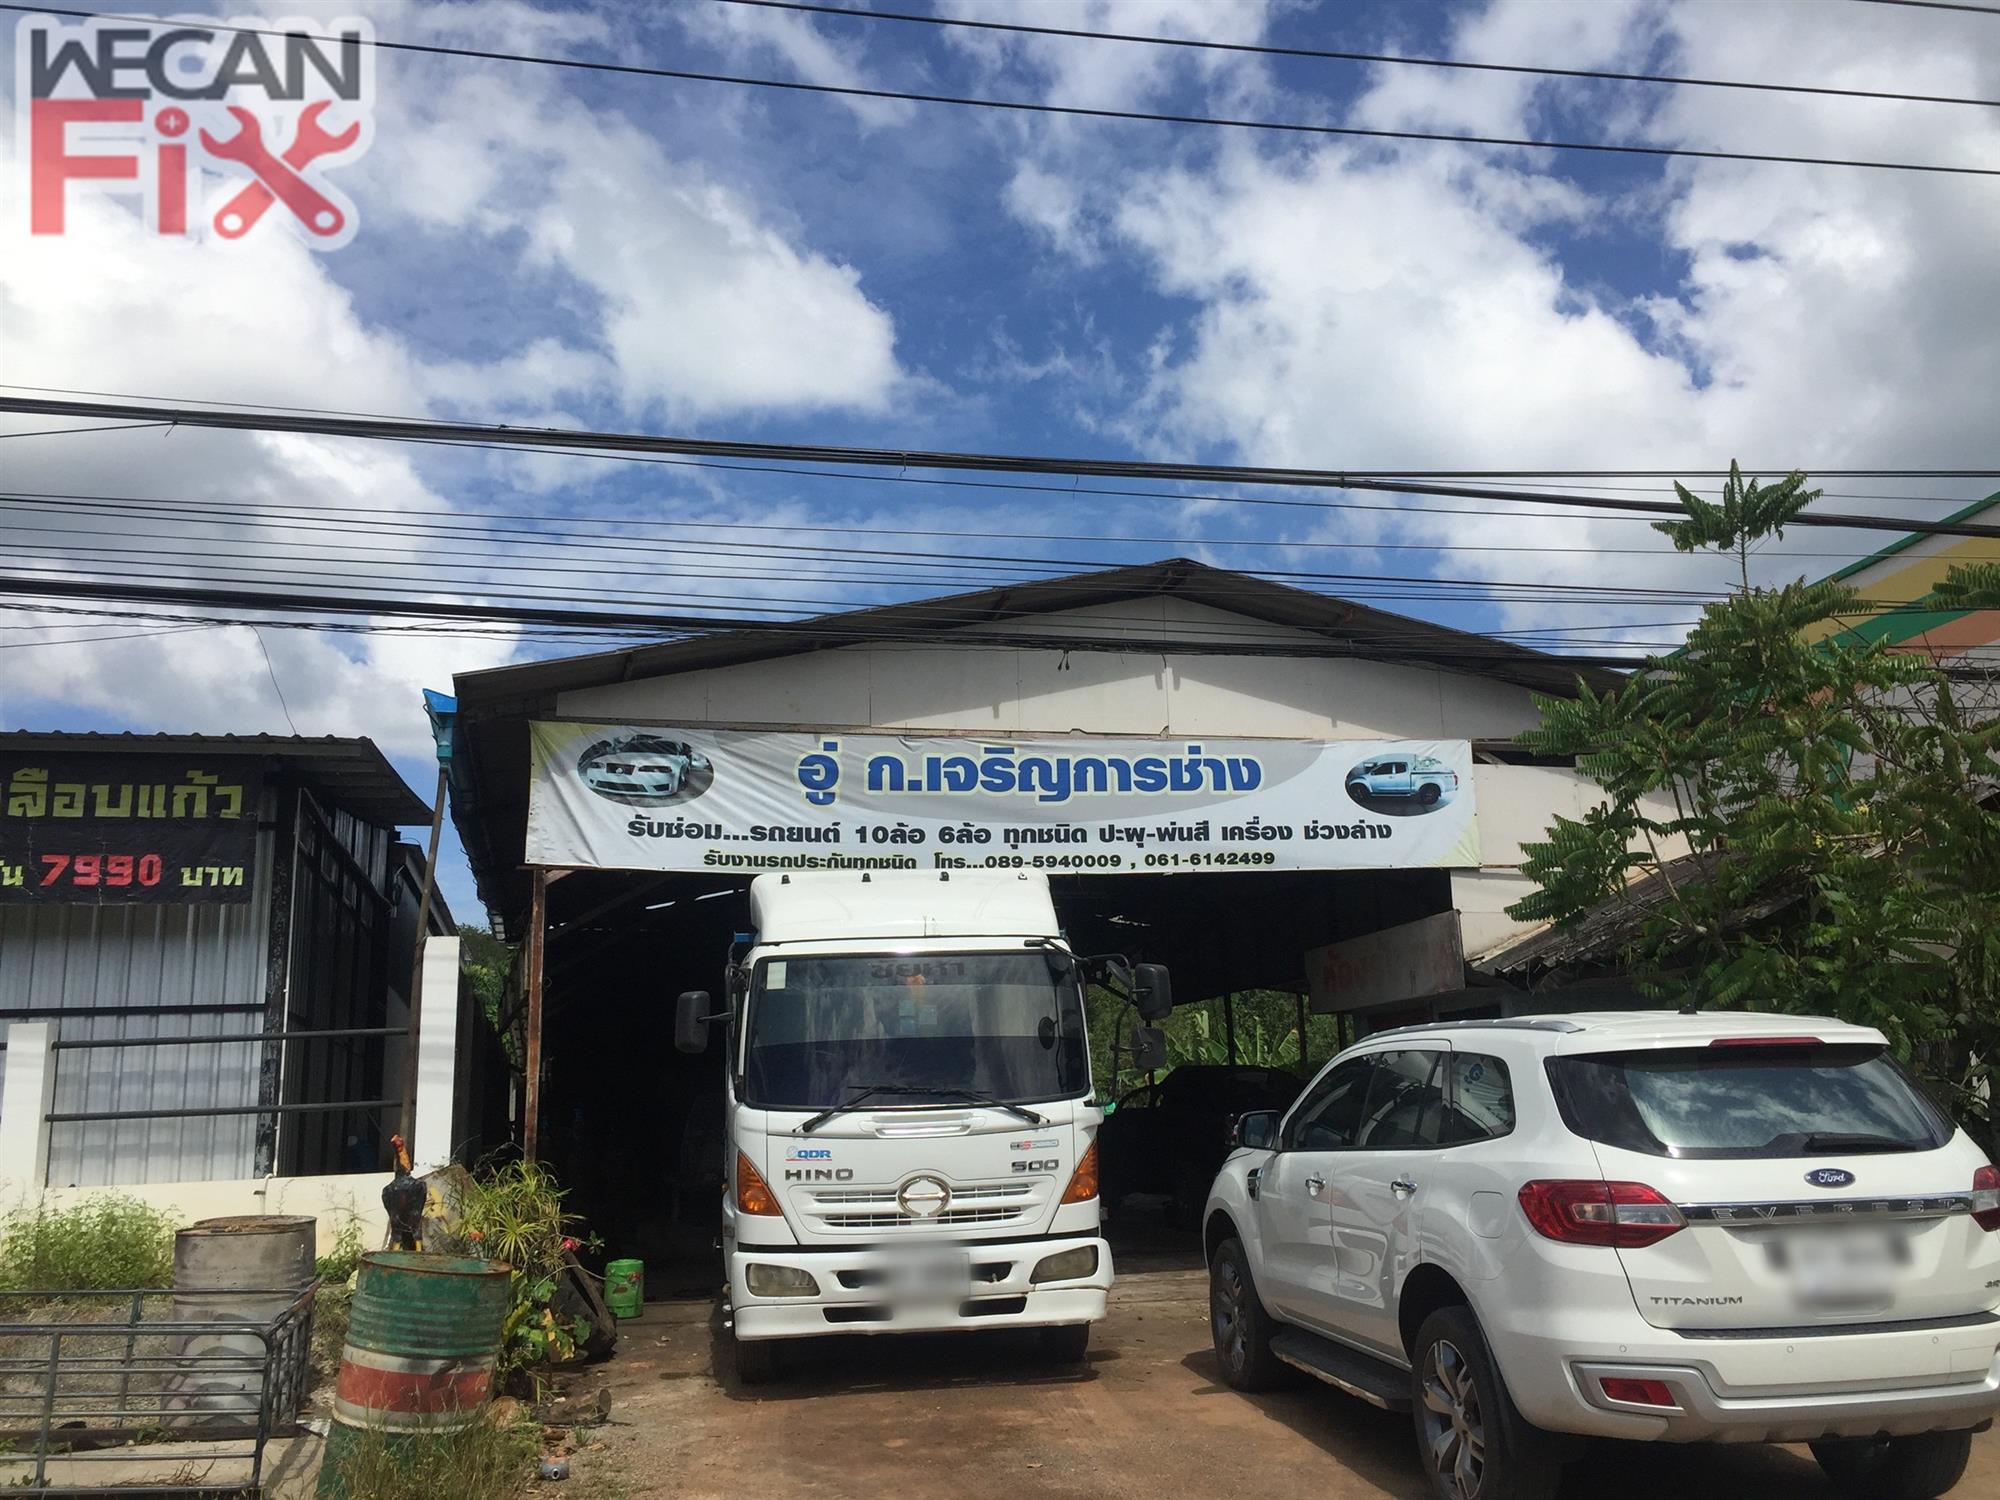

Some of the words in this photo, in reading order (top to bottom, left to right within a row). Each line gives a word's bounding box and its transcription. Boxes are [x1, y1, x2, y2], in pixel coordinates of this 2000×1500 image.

[799, 741, 840, 805] อู่
[867, 745, 1262, 802] ก.เจริญการช่าง
[0, 768, 243, 819] ลือบแก้ว
[855, 822, 926, 844] 10ล้อ
[938, 822, 992, 844] 6ล้อ
[1003, 823, 1088, 850] ทุกชนิด
[1221, 816, 1293, 842] เครื่อง
[1304, 820, 1392, 840] ช่วงล่าง
[40, 854, 163, 886] 7990
[179, 867, 244, 886] บาท
[1144, 852, 1275, 866] 061-6142499
[785, 1169, 854, 1181] HINO
[1011, 1159, 1059, 1173] 500
[1650, 1296, 1742, 1305] TITANIUM
